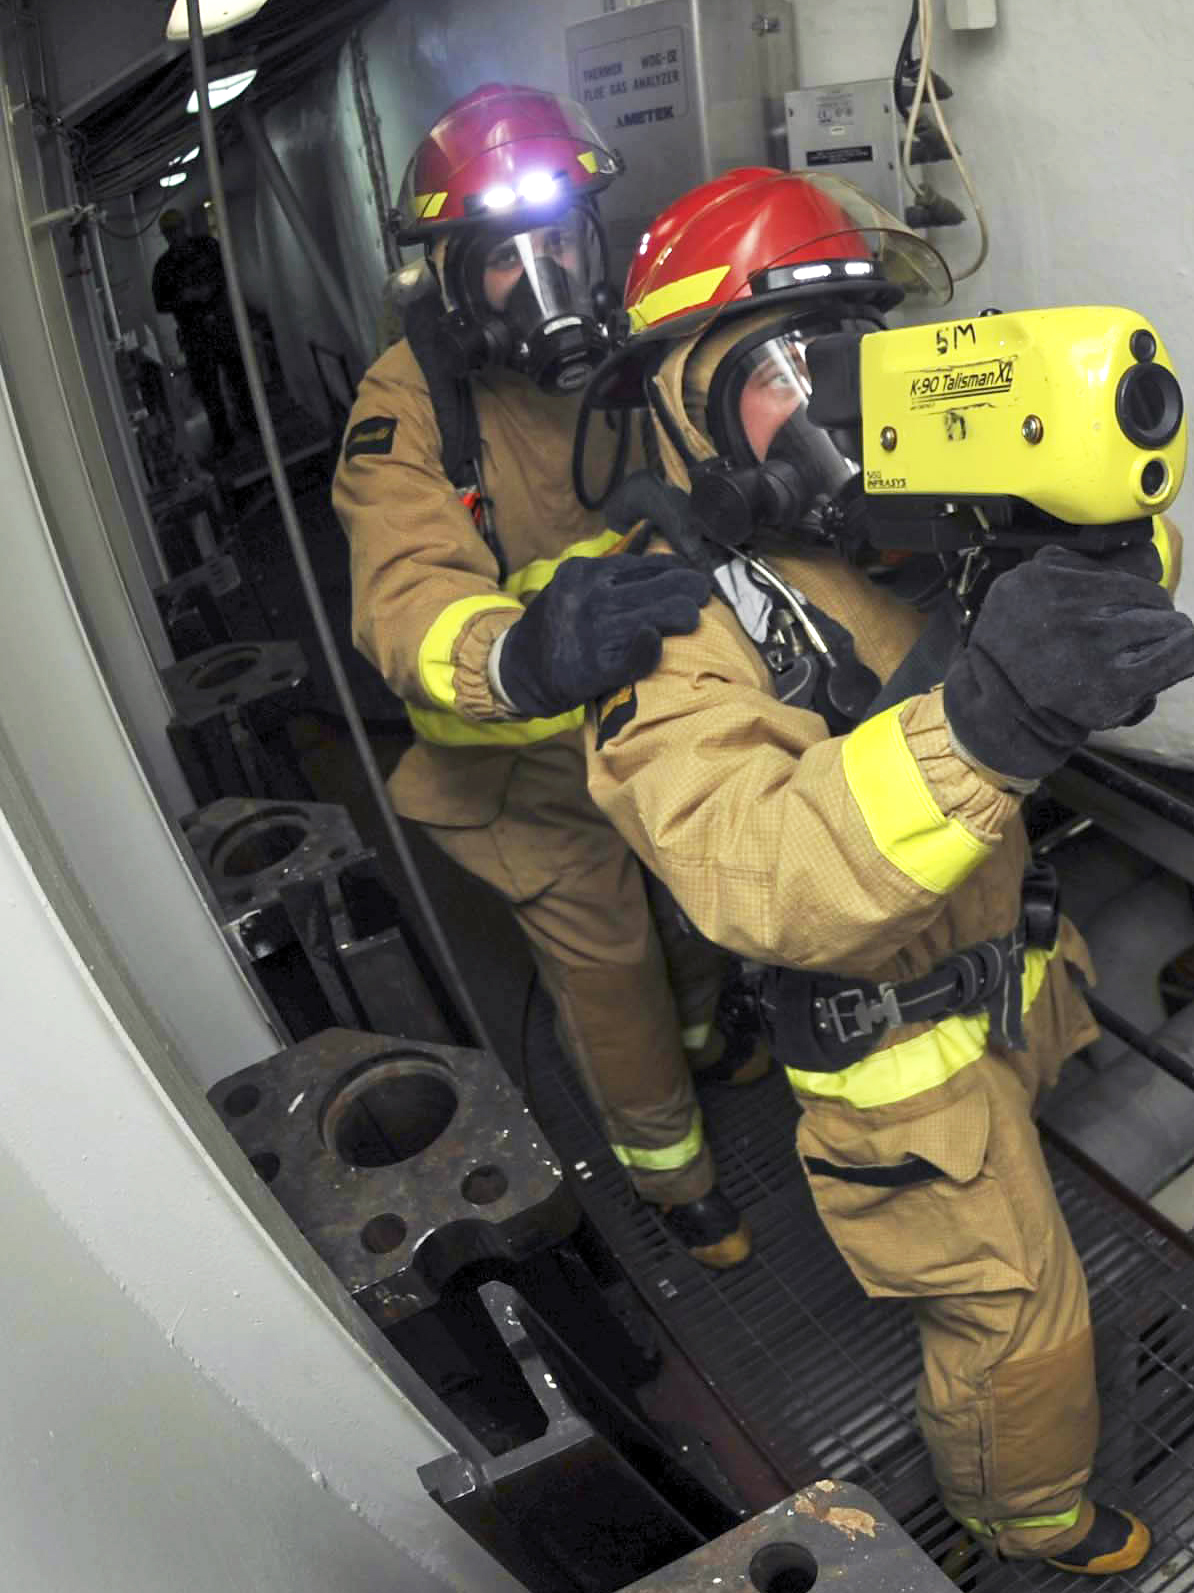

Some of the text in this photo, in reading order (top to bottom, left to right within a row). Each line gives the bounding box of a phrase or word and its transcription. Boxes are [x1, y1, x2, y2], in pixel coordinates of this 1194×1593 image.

[609, 81, 627, 95] GAS
[633, 69, 679, 89] ANALYZER
[910, 376, 940, 397] K-90
